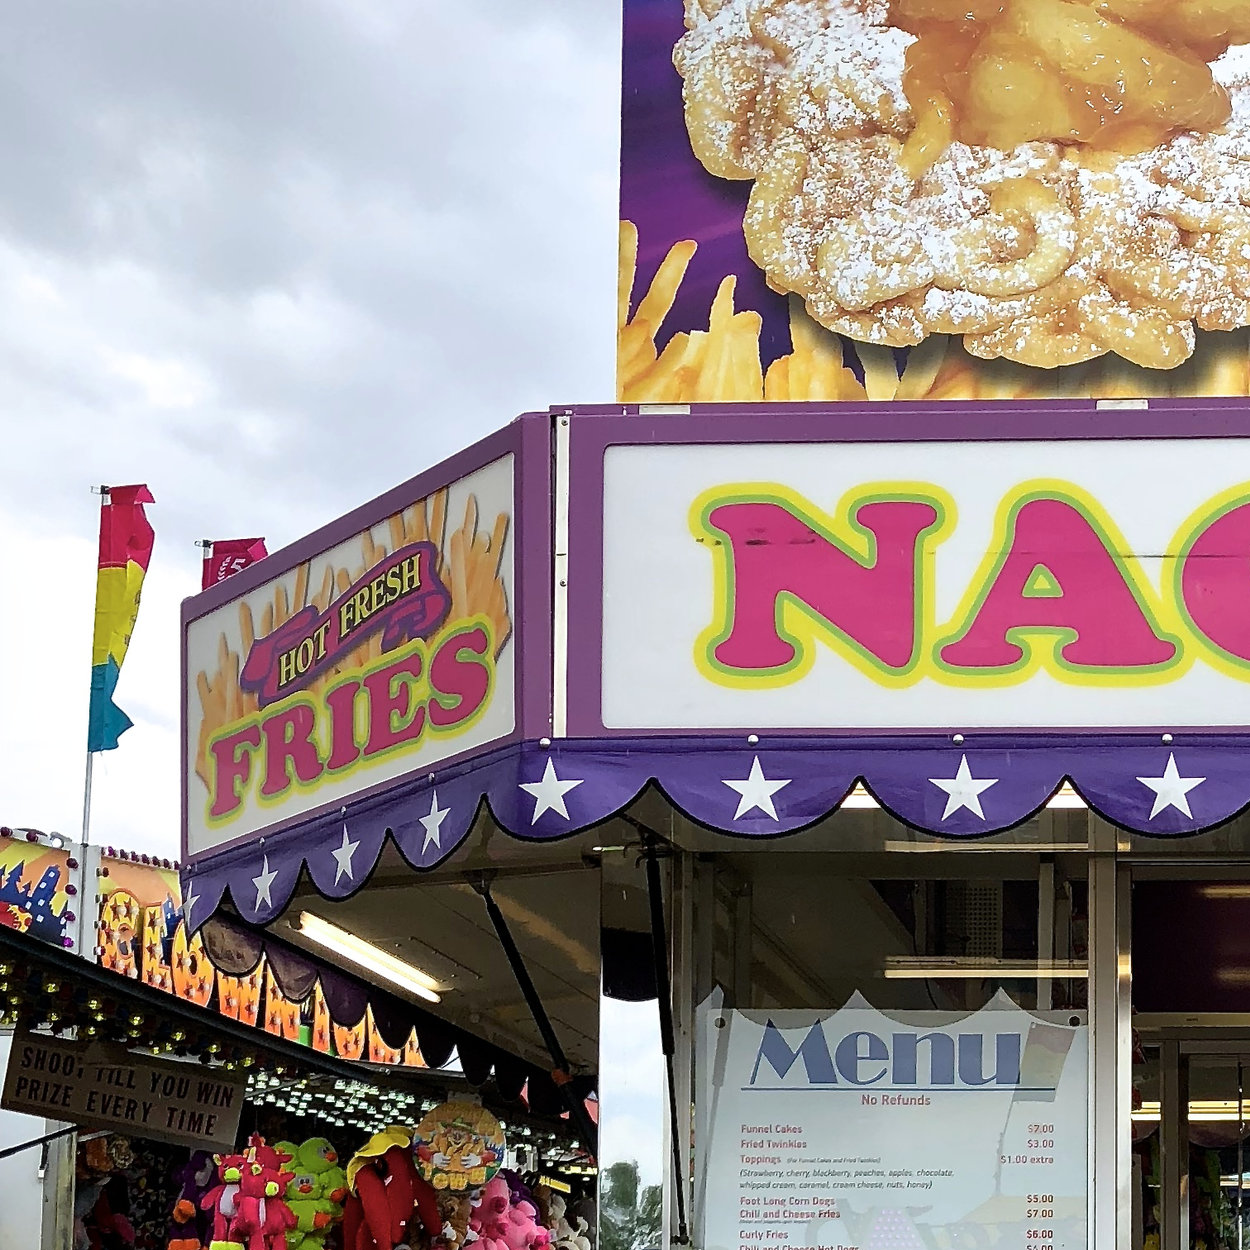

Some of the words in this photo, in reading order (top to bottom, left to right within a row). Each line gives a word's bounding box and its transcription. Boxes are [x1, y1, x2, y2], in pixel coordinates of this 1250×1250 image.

[277, 619, 331, 688] HOT
[338, 552, 421, 639] FRESH
[208, 617, 495, 824] FRIES
[750, 1018, 1021, 1085] Menu
[150, 1071, 190, 1099] YOU
[196, 1081, 234, 1108] WIN
[861, 1095, 878, 1106] No
[881, 1094, 931, 1106] Refunds
[15, 1075, 74, 1107] PRIZE
[86, 1090, 153, 1123] EVERY
[166, 1106, 218, 1137] TIME
[741, 1124, 772, 1134] Funnel
[775, 1124, 803, 1134] Cakes
[1028, 1124, 1054, 1134] $7.00
[741, 1139, 764, 1149] Fried
[767, 1139, 807, 1149] Twinkies
[1027, 1139, 1054, 1149] $3.00
[740, 1154, 781, 1165] Toppings
[1000, 1155, 1027, 1164] $1.00
[1030, 1155, 1054, 1164] extra
[739, 1181, 771, 1190] whipped
[772, 1181, 797, 1190] cream,
[832, 1181, 856, 1190] cream
[907, 1181, 933, 1190] honey)
[740, 1196, 761, 1206] Foot
[763, 1196, 786, 1206] Long
[789, 1196, 810, 1206] Corn
[812, 1196, 835, 1206] Dogs
[1027, 1194, 1054, 1203] $5.00
[740, 1209, 760, 1219] Chili
[762, 1209, 780, 1219] and
[783, 1209, 816, 1219] Cheese
[818, 1209, 841, 1219] Fries
[1026, 1209, 1054, 1218] $7.00
[739, 1230, 764, 1240] Curly
[766, 1230, 789, 1240] Fries
[1026, 1229, 1053, 1239] $6.00
